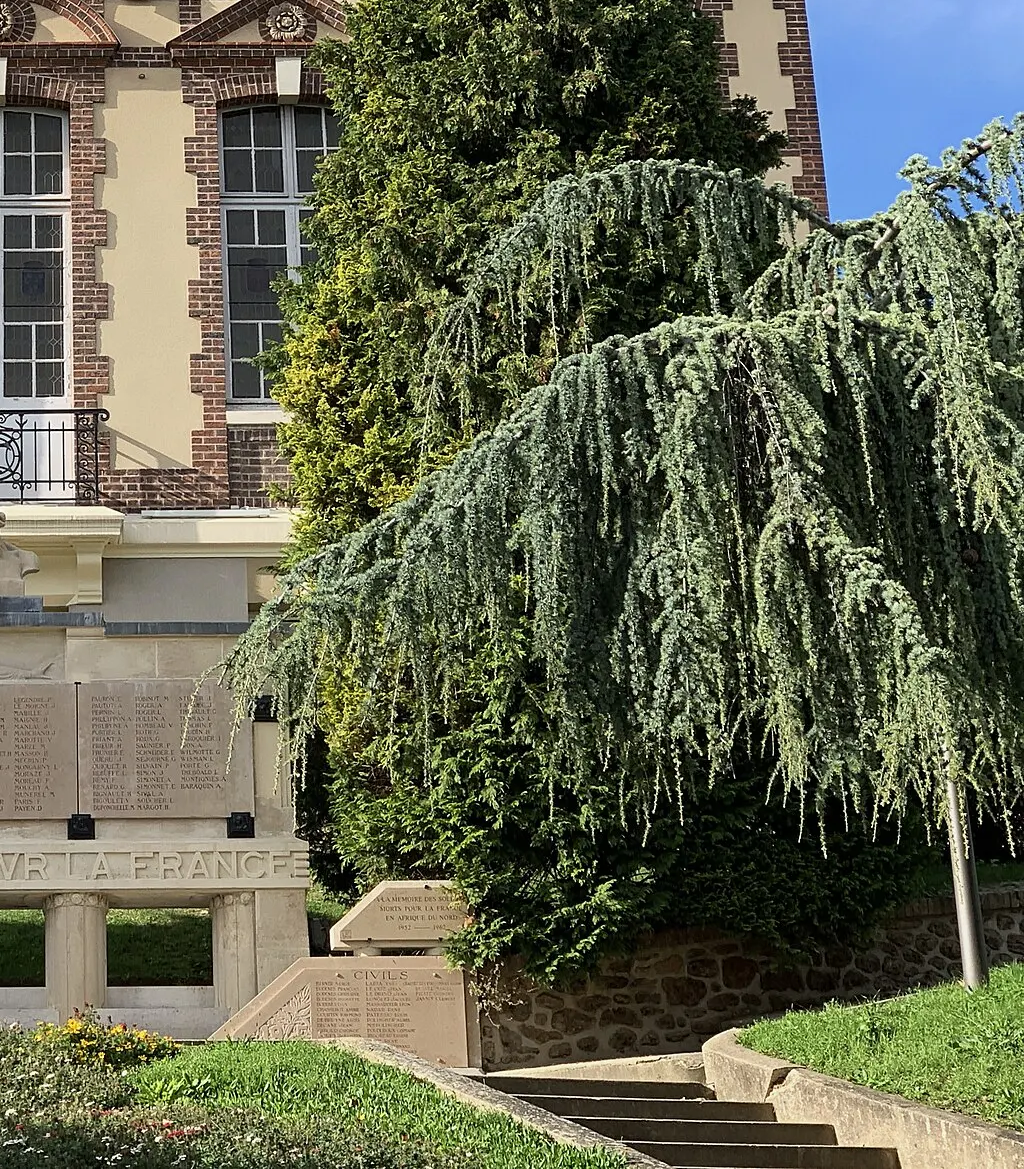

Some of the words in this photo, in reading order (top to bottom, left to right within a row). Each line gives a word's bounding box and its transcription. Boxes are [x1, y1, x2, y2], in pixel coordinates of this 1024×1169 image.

[66, 852, 112, 880] LA
[131, 851, 288, 880] FRANCE
[354, 971, 409, 980] CIVILS
